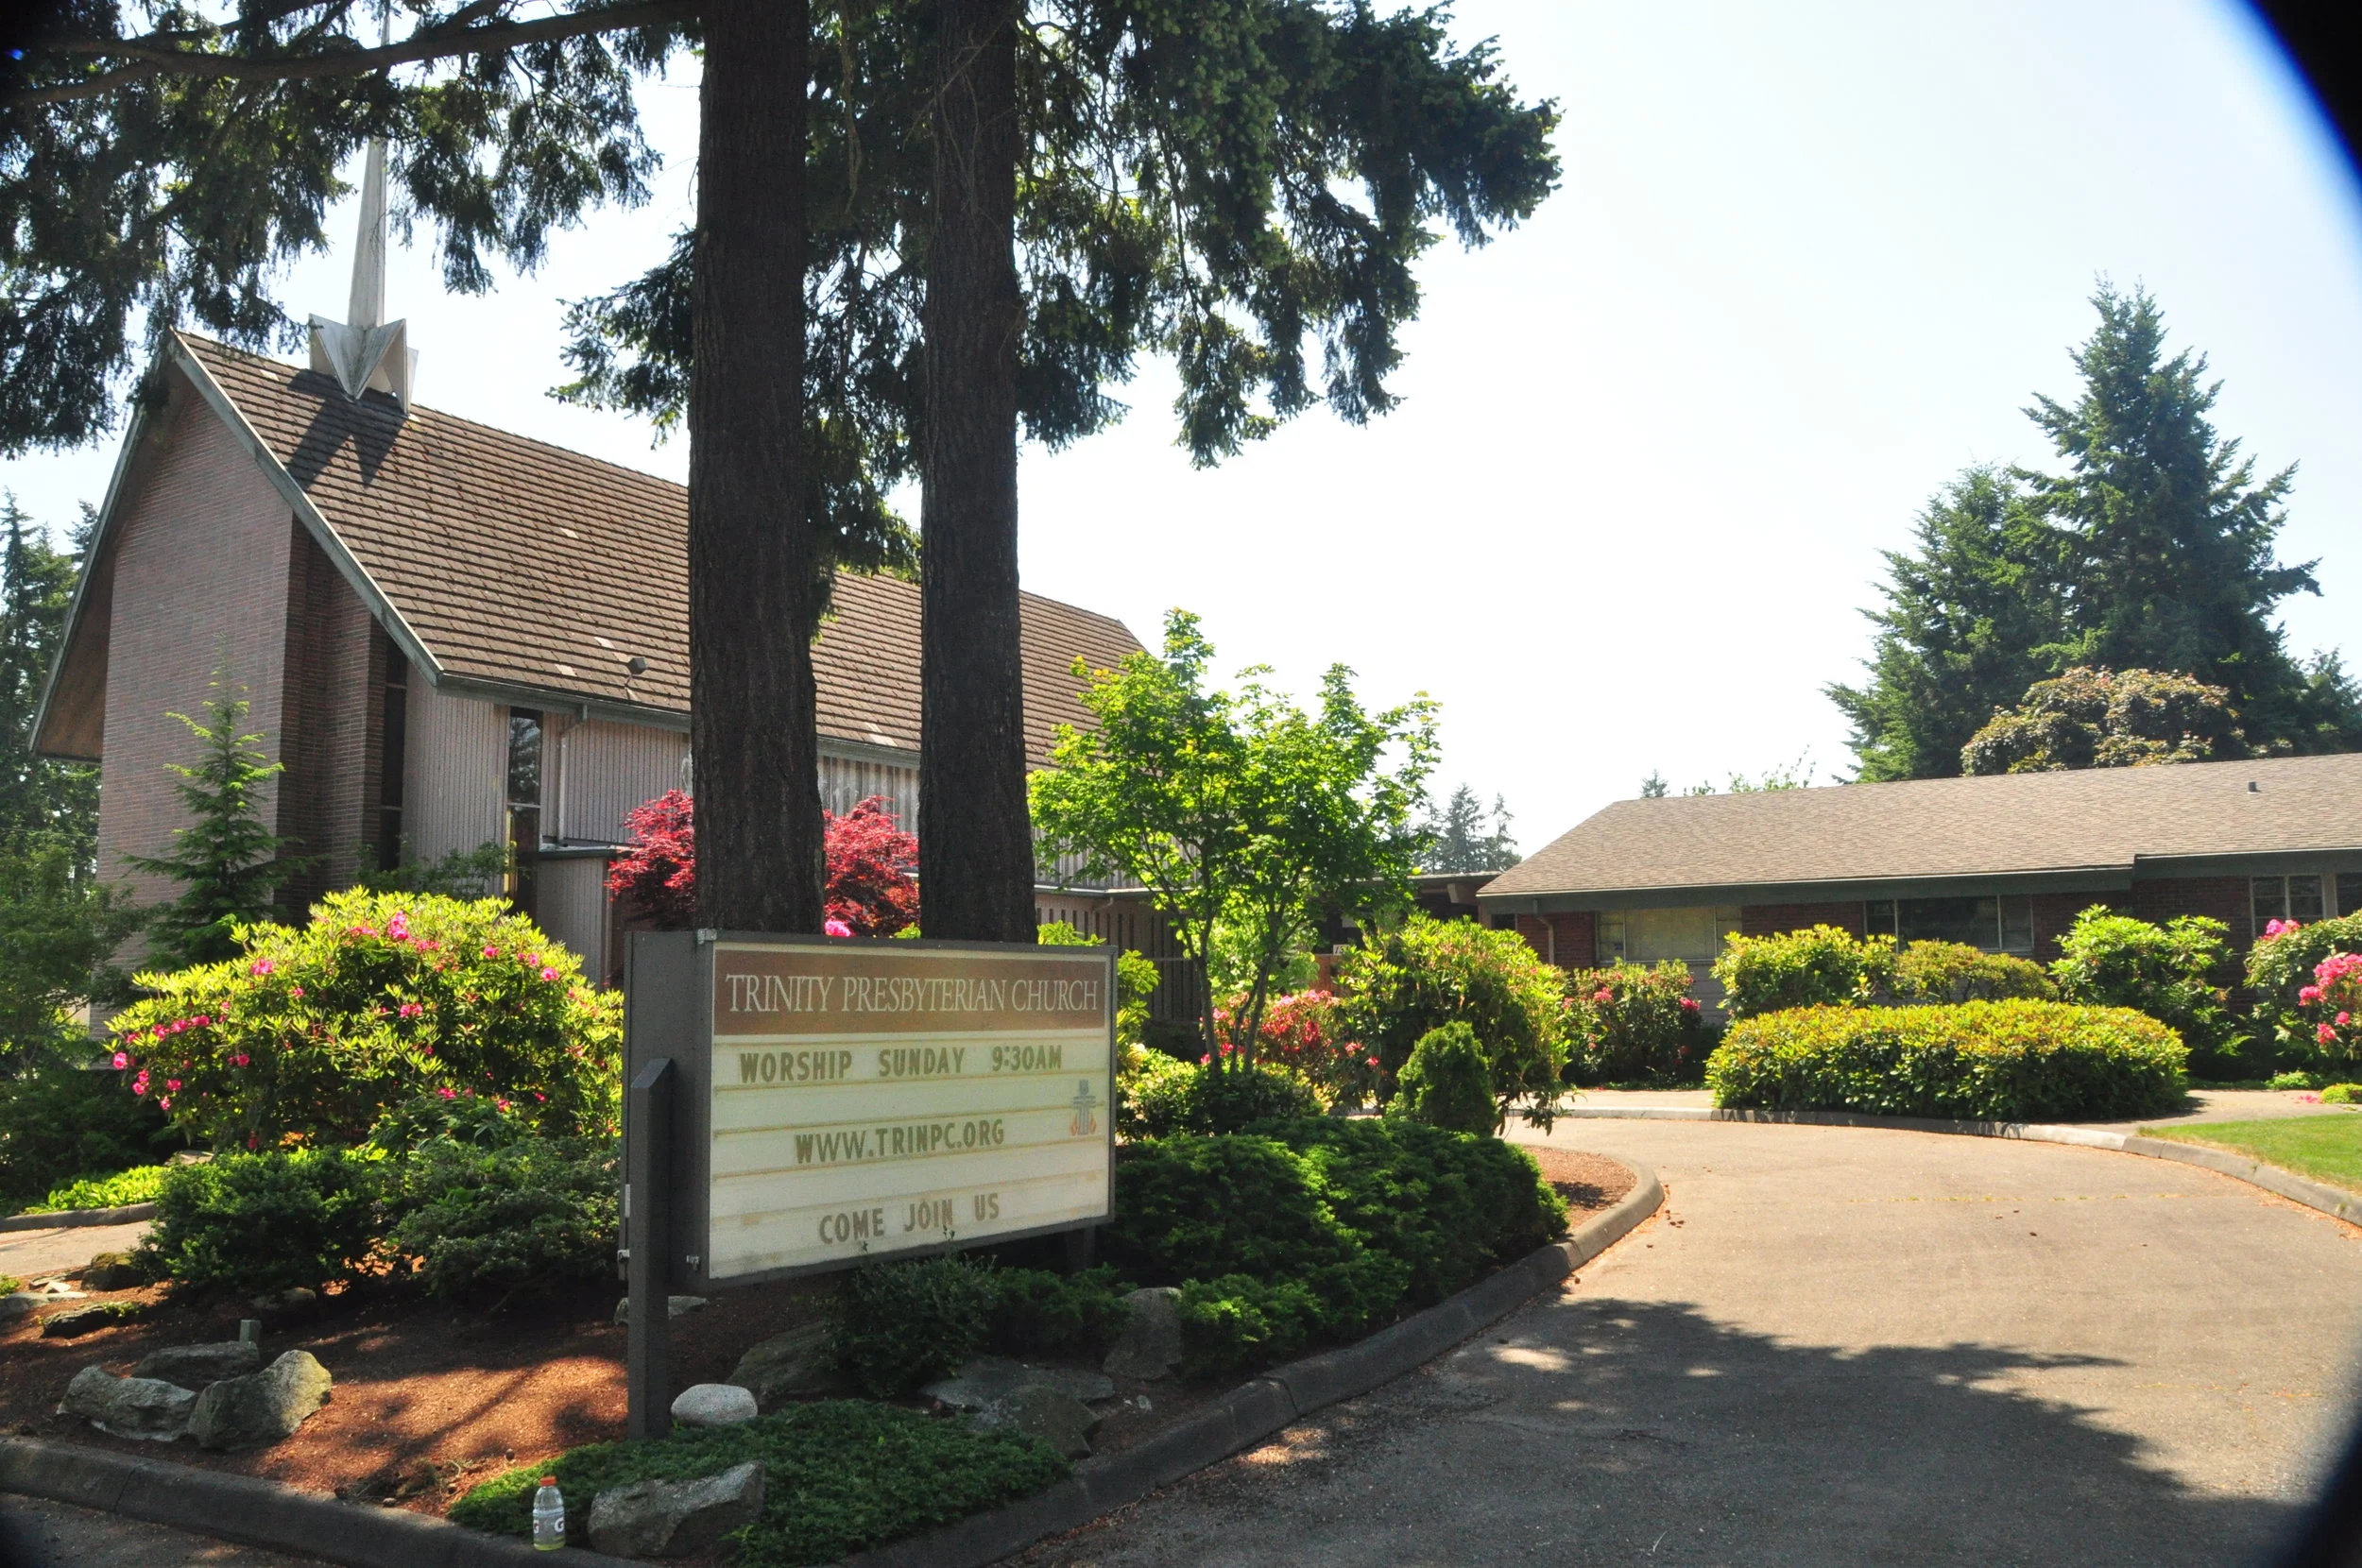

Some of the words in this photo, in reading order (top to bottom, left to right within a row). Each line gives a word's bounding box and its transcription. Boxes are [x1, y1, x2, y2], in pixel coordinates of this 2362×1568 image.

[726, 974, 834, 1012] TRINITY
[841, 977, 1006, 1012] PRESBYTERIAN
[1012, 980, 1097, 1012] CHURCH
[740, 1050, 851, 1082] WORSHIP
[879, 1047, 966, 1077] SUNDAY
[992, 1045, 1062, 1071] 9:30AM
[796, 1119, 1004, 1164] WWW.TRINPC.ORG
[819, 1208, 884, 1244] COME
[903, 1199, 953, 1232] JOIN
[974, 1193, 1000, 1221] US
